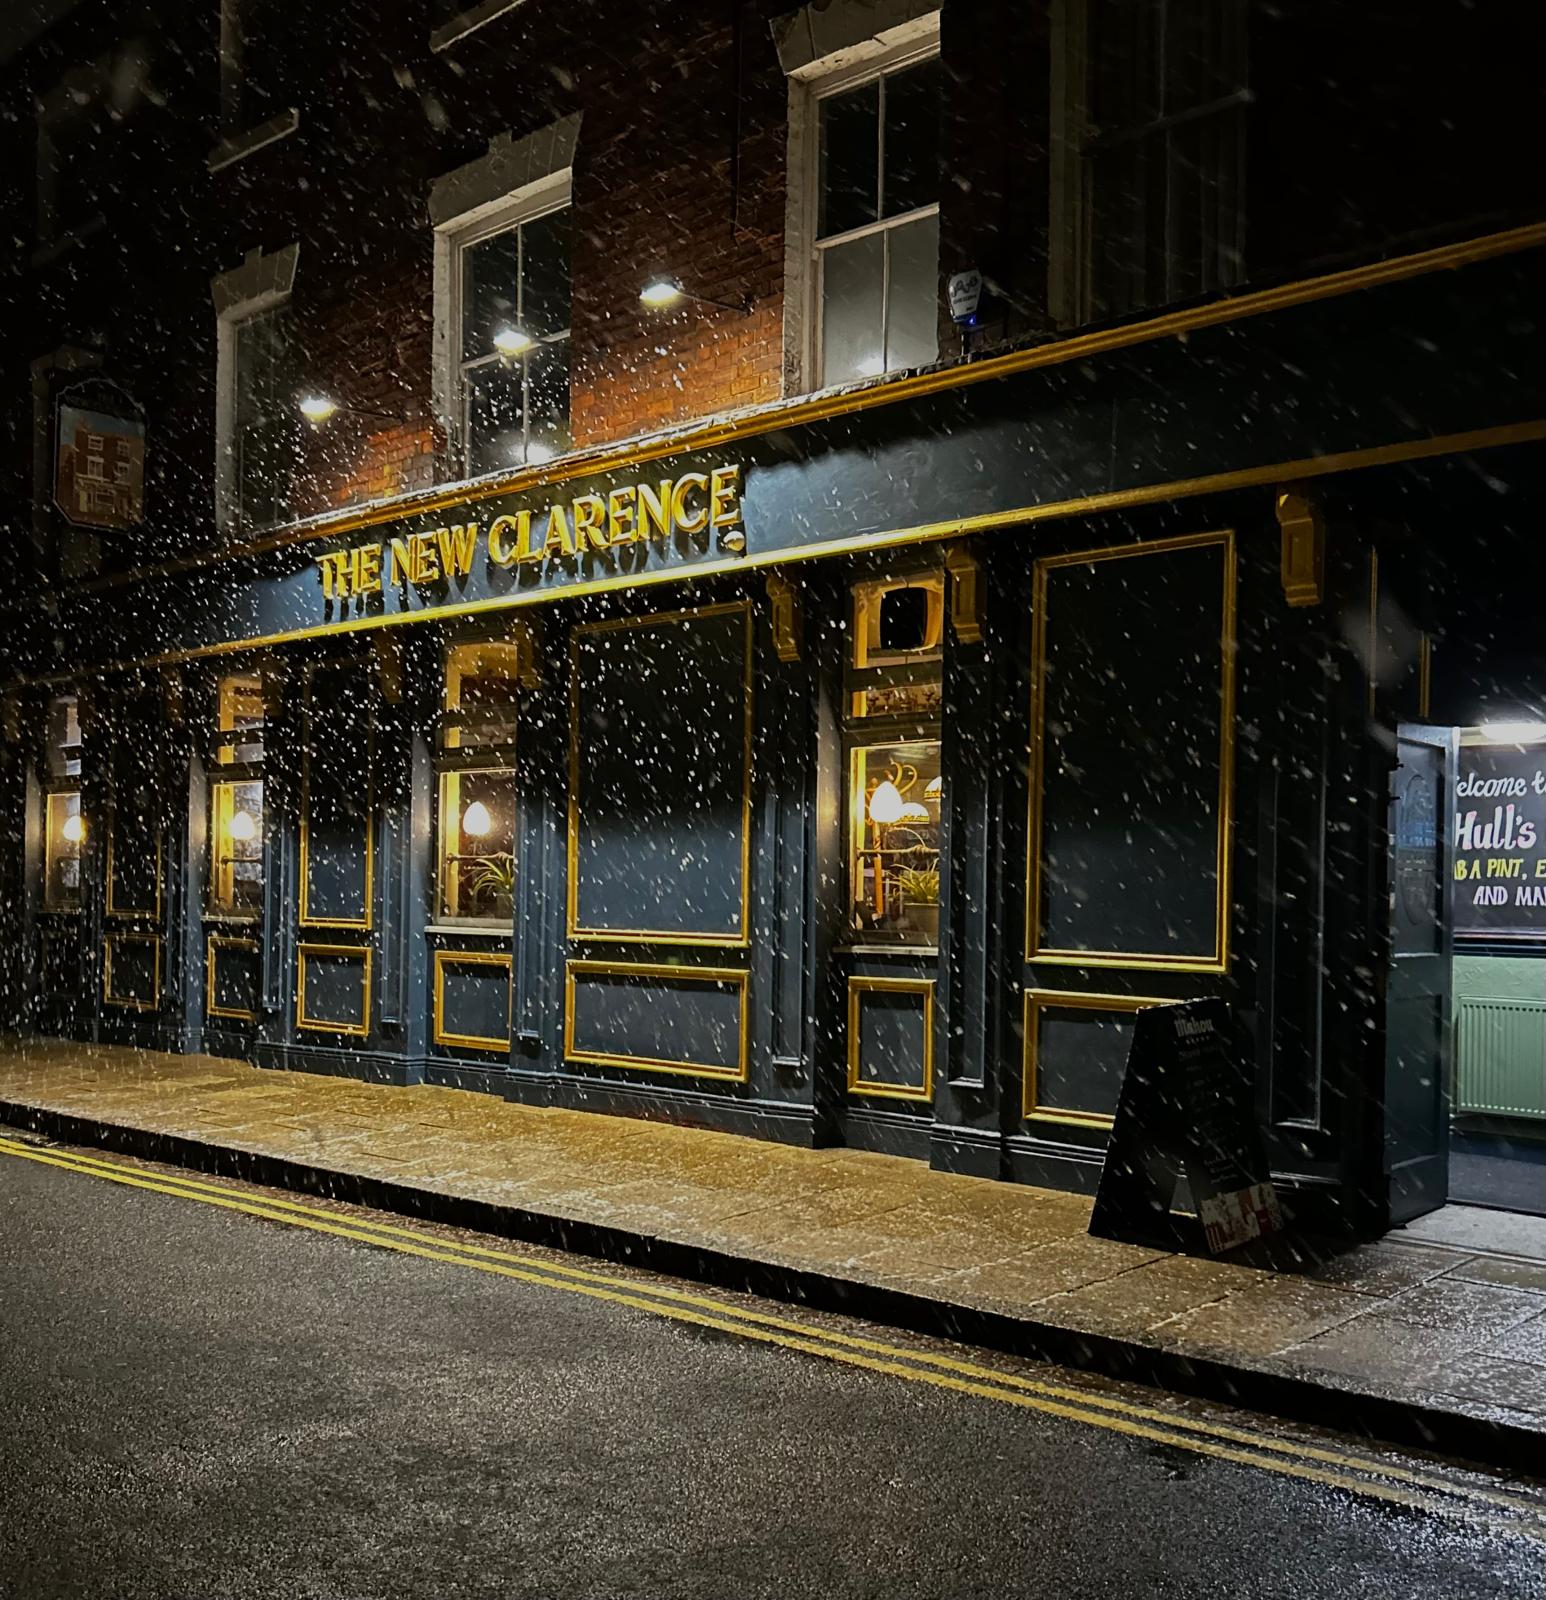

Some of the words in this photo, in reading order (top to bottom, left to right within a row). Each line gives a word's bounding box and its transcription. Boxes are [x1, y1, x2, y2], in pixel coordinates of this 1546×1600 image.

[315, 543, 382, 600] THE
[390, 522, 478, 587] NEW
[488, 464, 740, 567] CLARENCE
[1455, 772, 1527, 797] elcome
[1455, 803, 1537, 850] Hull's
[1454, 859, 1468, 880] B
[1469, 859, 1482, 880] A
[1486, 858, 1527, 880] PINT,
[1535, 859, 1546, 878] E
[1472, 885, 1508, 906] AND
